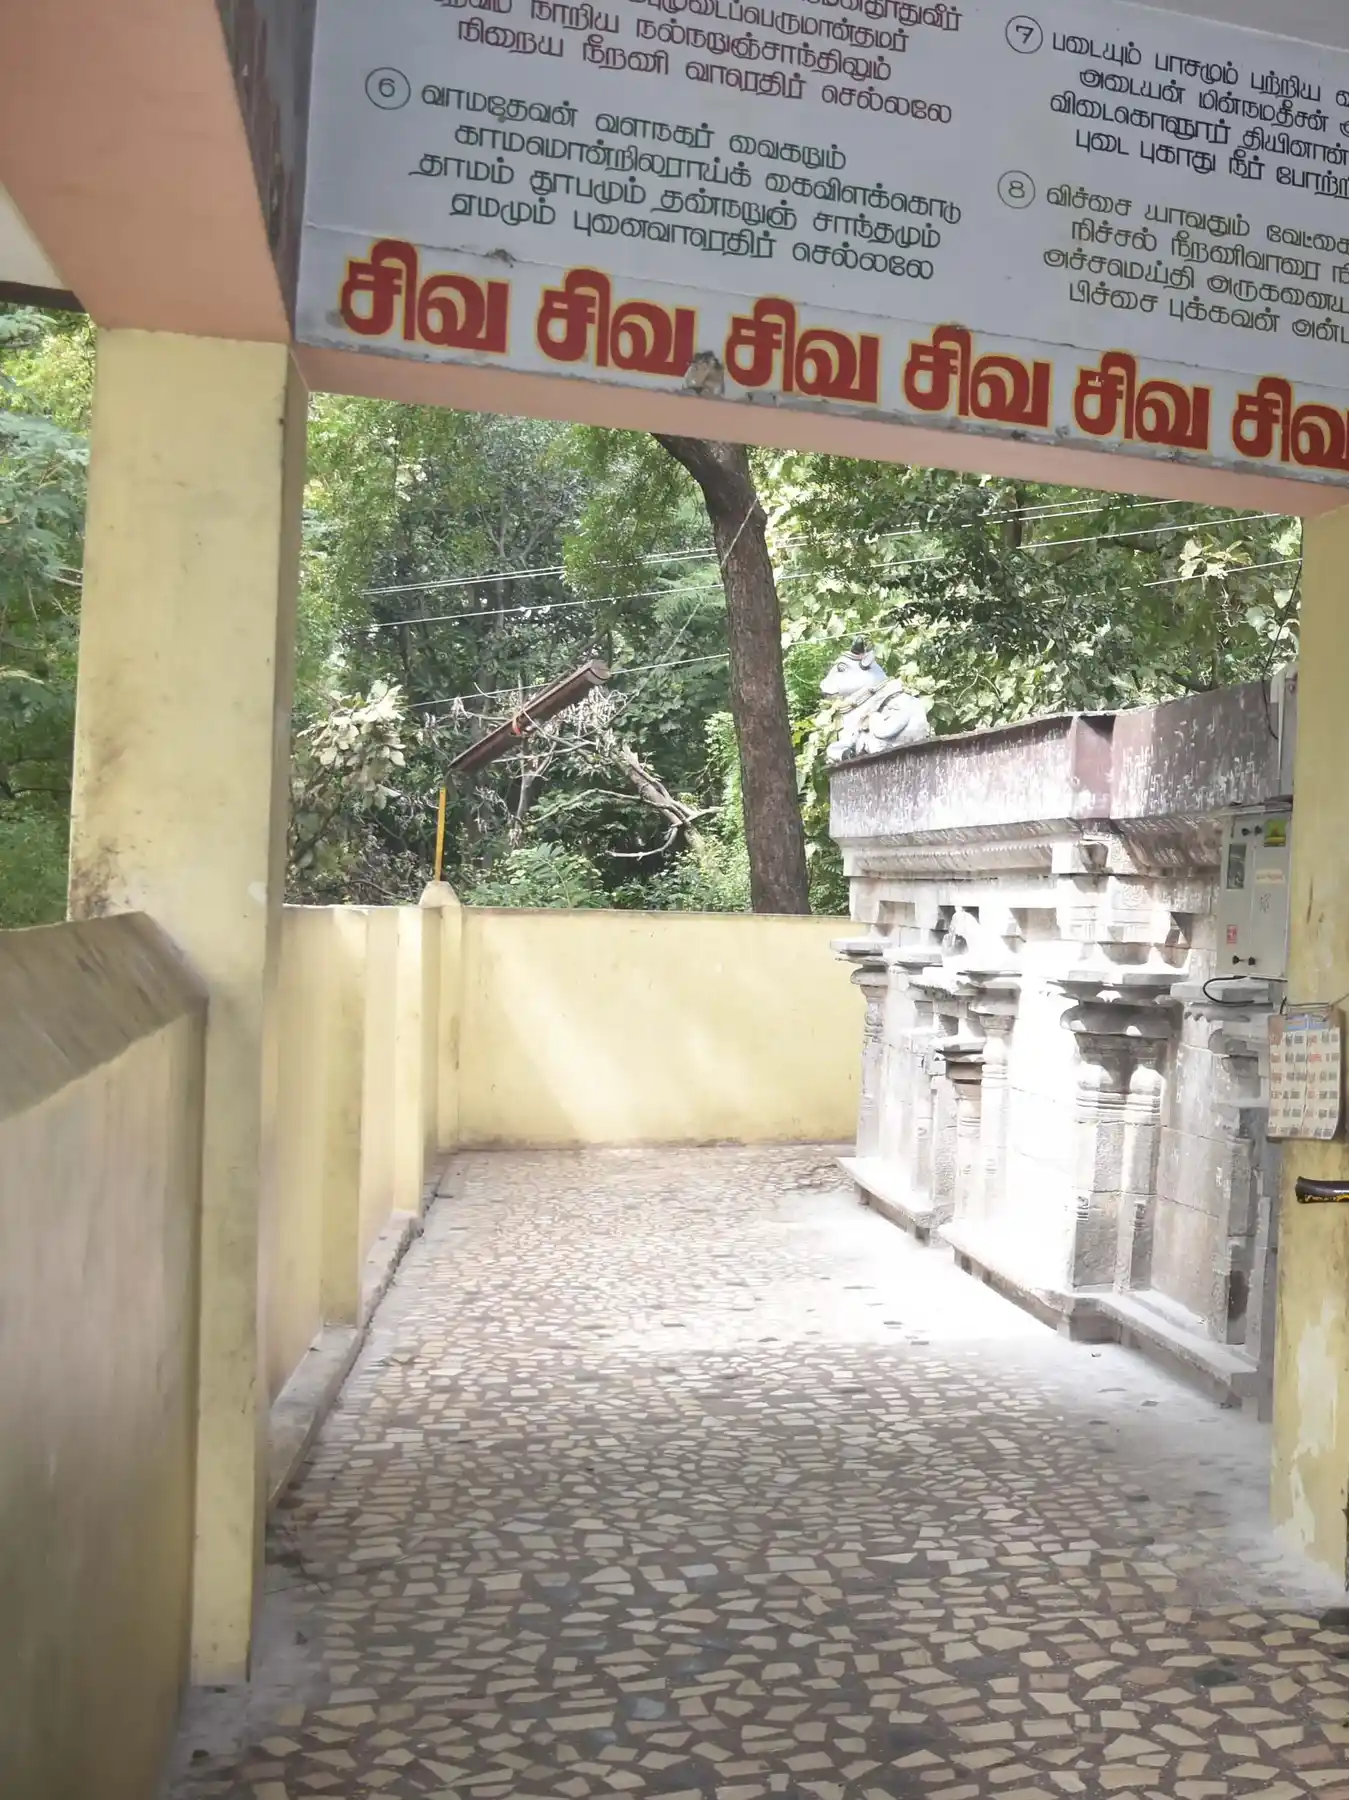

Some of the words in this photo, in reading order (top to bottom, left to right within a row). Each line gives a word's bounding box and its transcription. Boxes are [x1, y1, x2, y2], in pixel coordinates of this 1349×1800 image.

[1075, 128, 1130, 156] புடை
[341, 239, 512, 354] சிவ
[537, 266, 697, 377] சிவ
[724, 295, 882, 404] சிவ
[903, 322, 1050, 427] சிவ
[1074, 350, 1211, 449] சிவ
